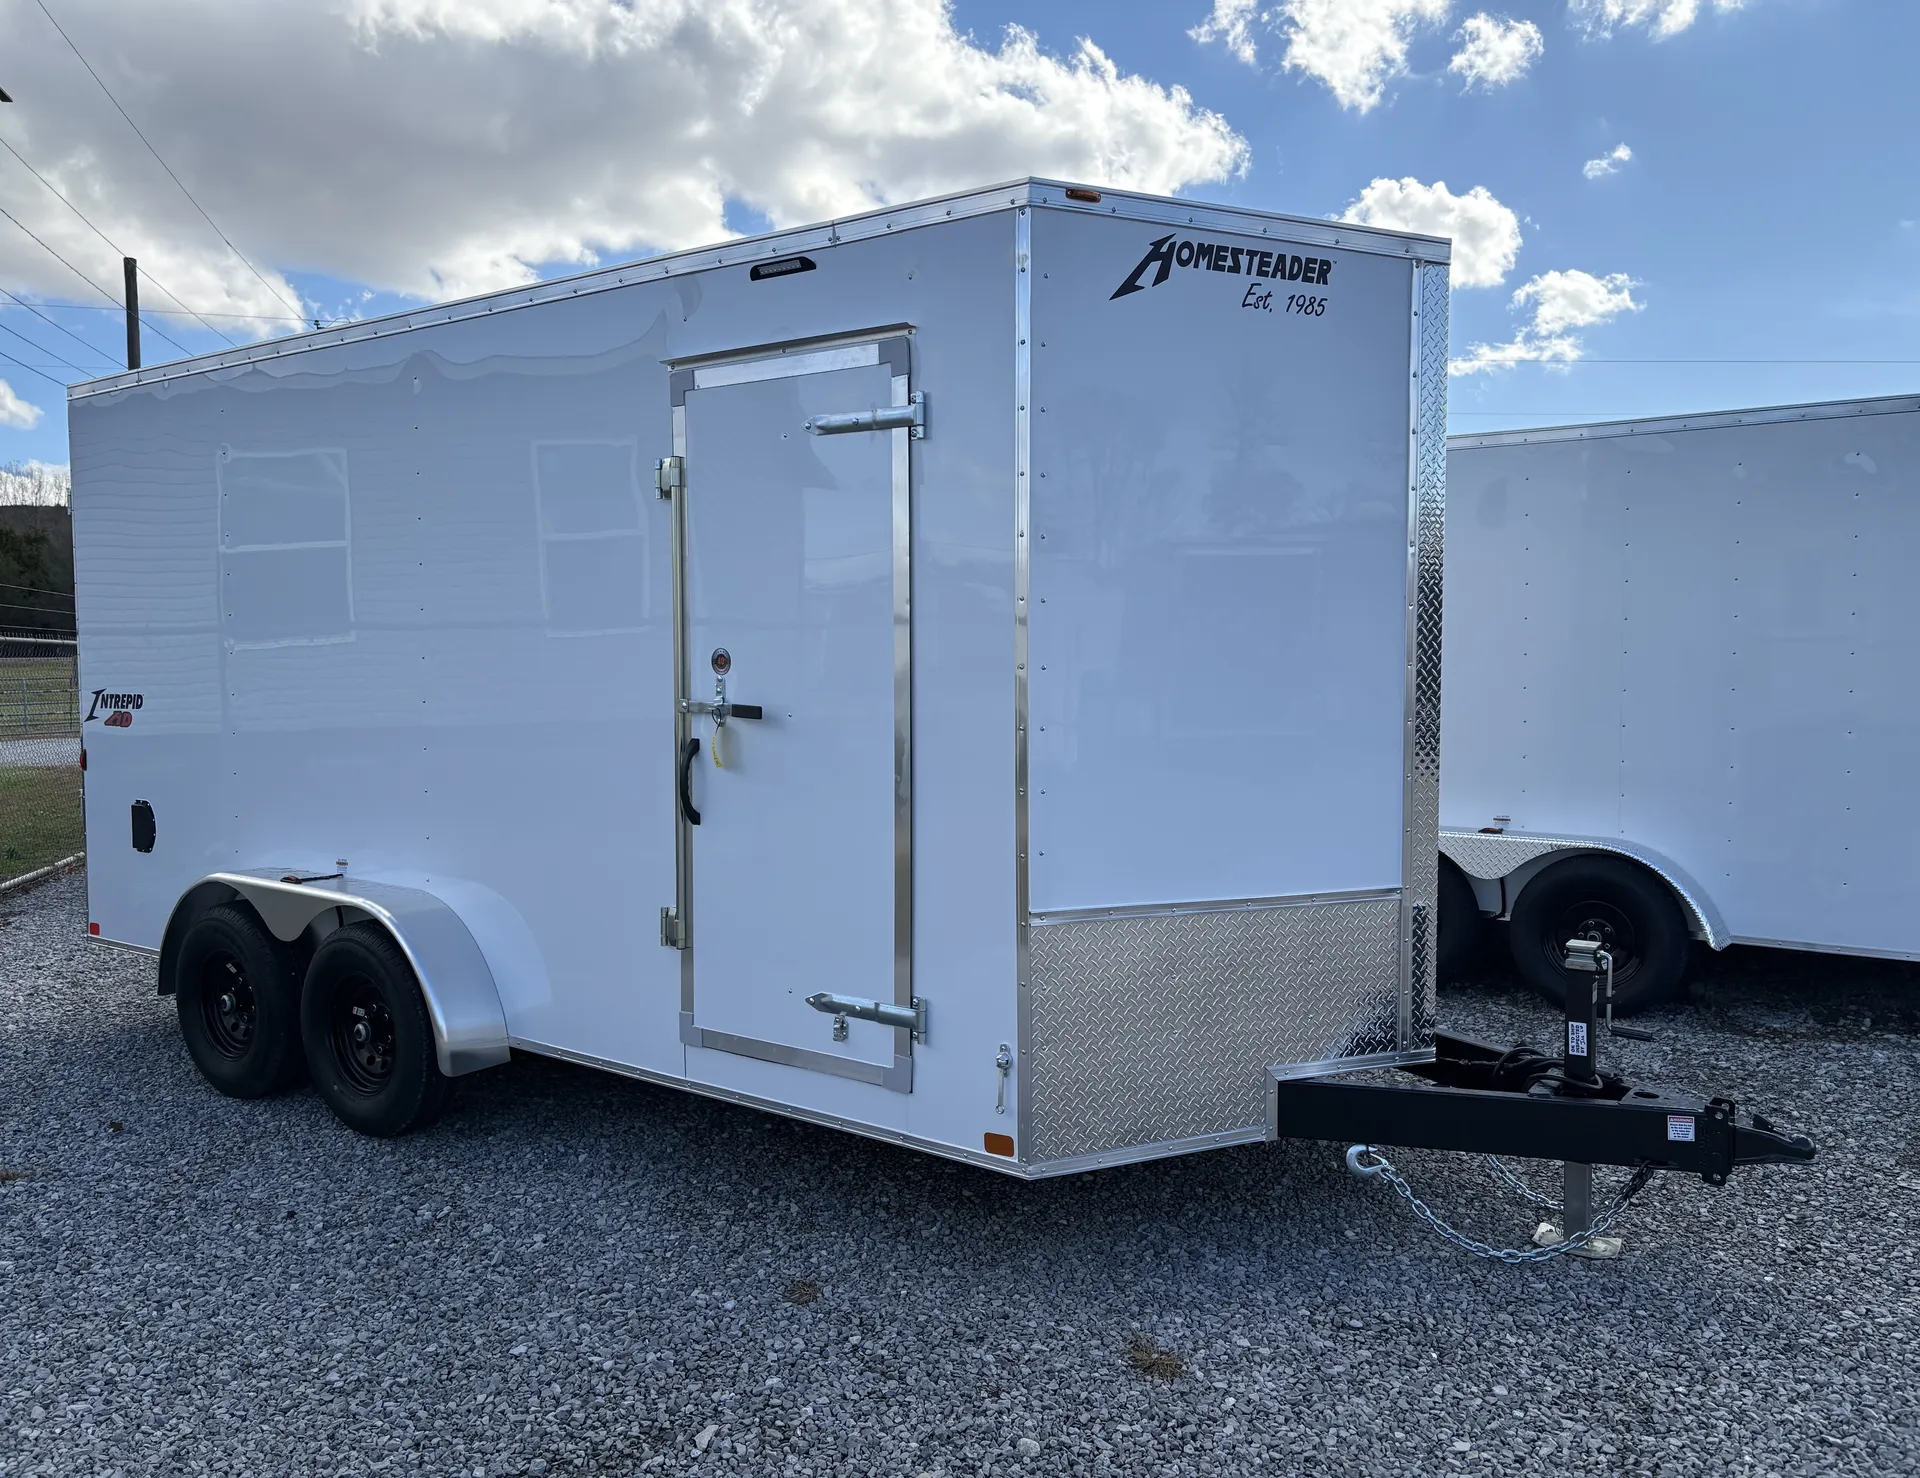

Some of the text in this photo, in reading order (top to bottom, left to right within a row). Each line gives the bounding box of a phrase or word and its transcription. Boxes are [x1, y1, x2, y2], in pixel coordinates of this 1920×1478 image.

[1109, 233, 1332, 301] HOMESTEADER
[1286, 294, 1329, 317] 1985
[84, 688, 143, 722] INTREPID
